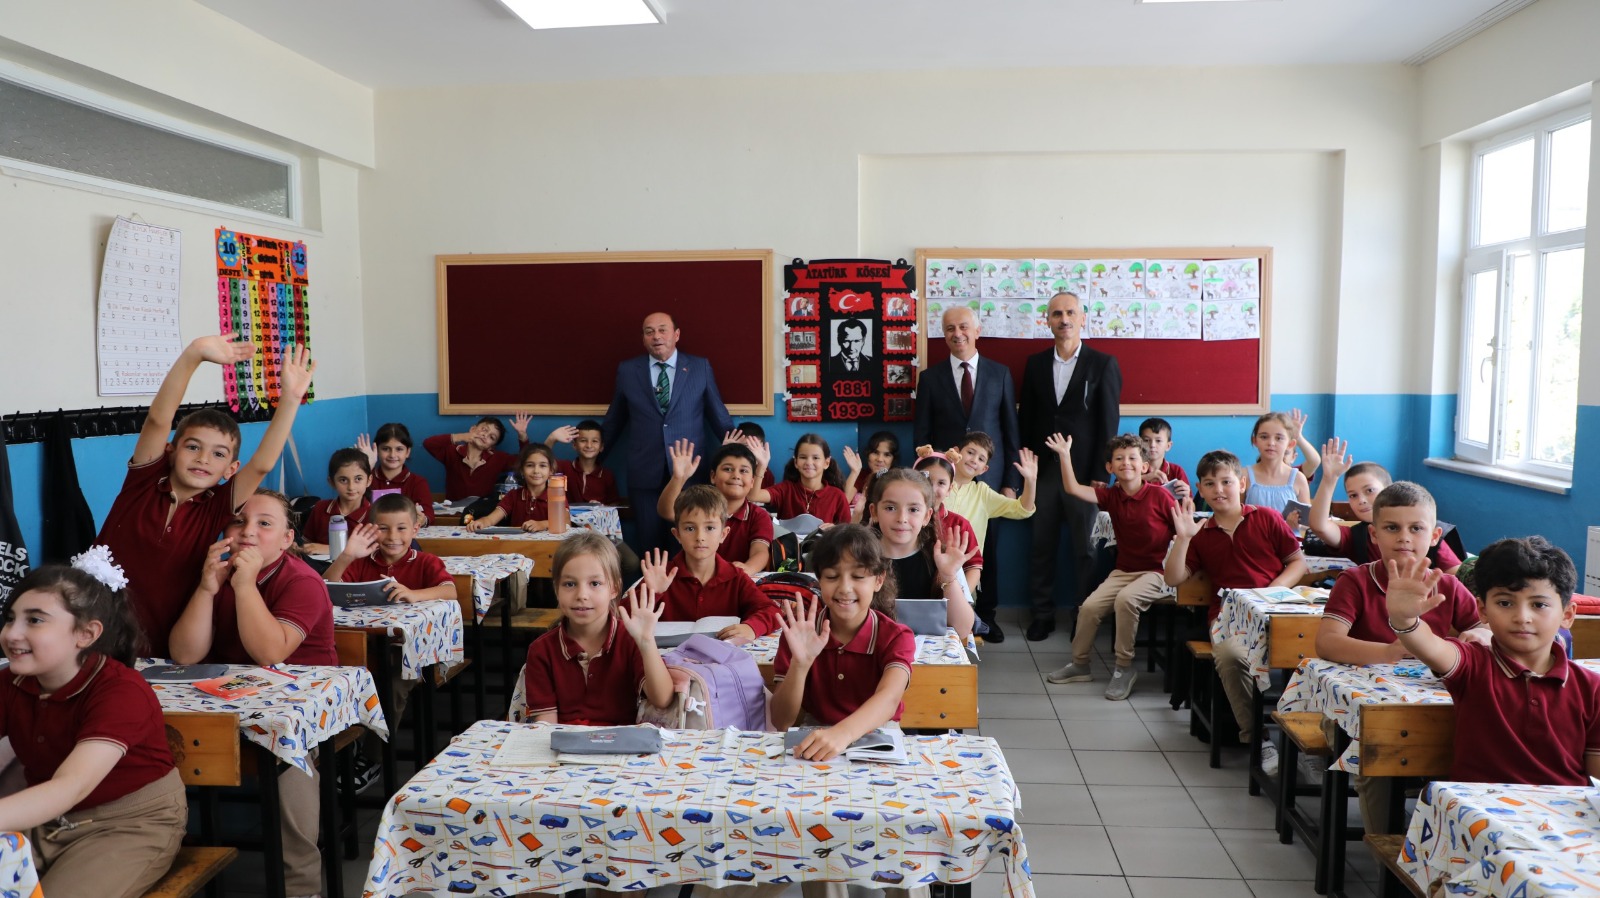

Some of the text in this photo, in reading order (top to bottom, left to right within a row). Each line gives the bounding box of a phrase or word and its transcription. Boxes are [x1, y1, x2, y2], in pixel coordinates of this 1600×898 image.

[147, 235, 152, 243] D
[224, 242, 236, 254] 10
[296, 253, 304, 264] 12
[129, 262, 133, 270] N
[145, 265, 150, 273] O
[806, 265, 892, 280] ATATÜRK KÖŞESİ
[128, 293, 132, 302] Z
[143, 295, 148, 303] Q
[833, 381, 871, 396] 1881
